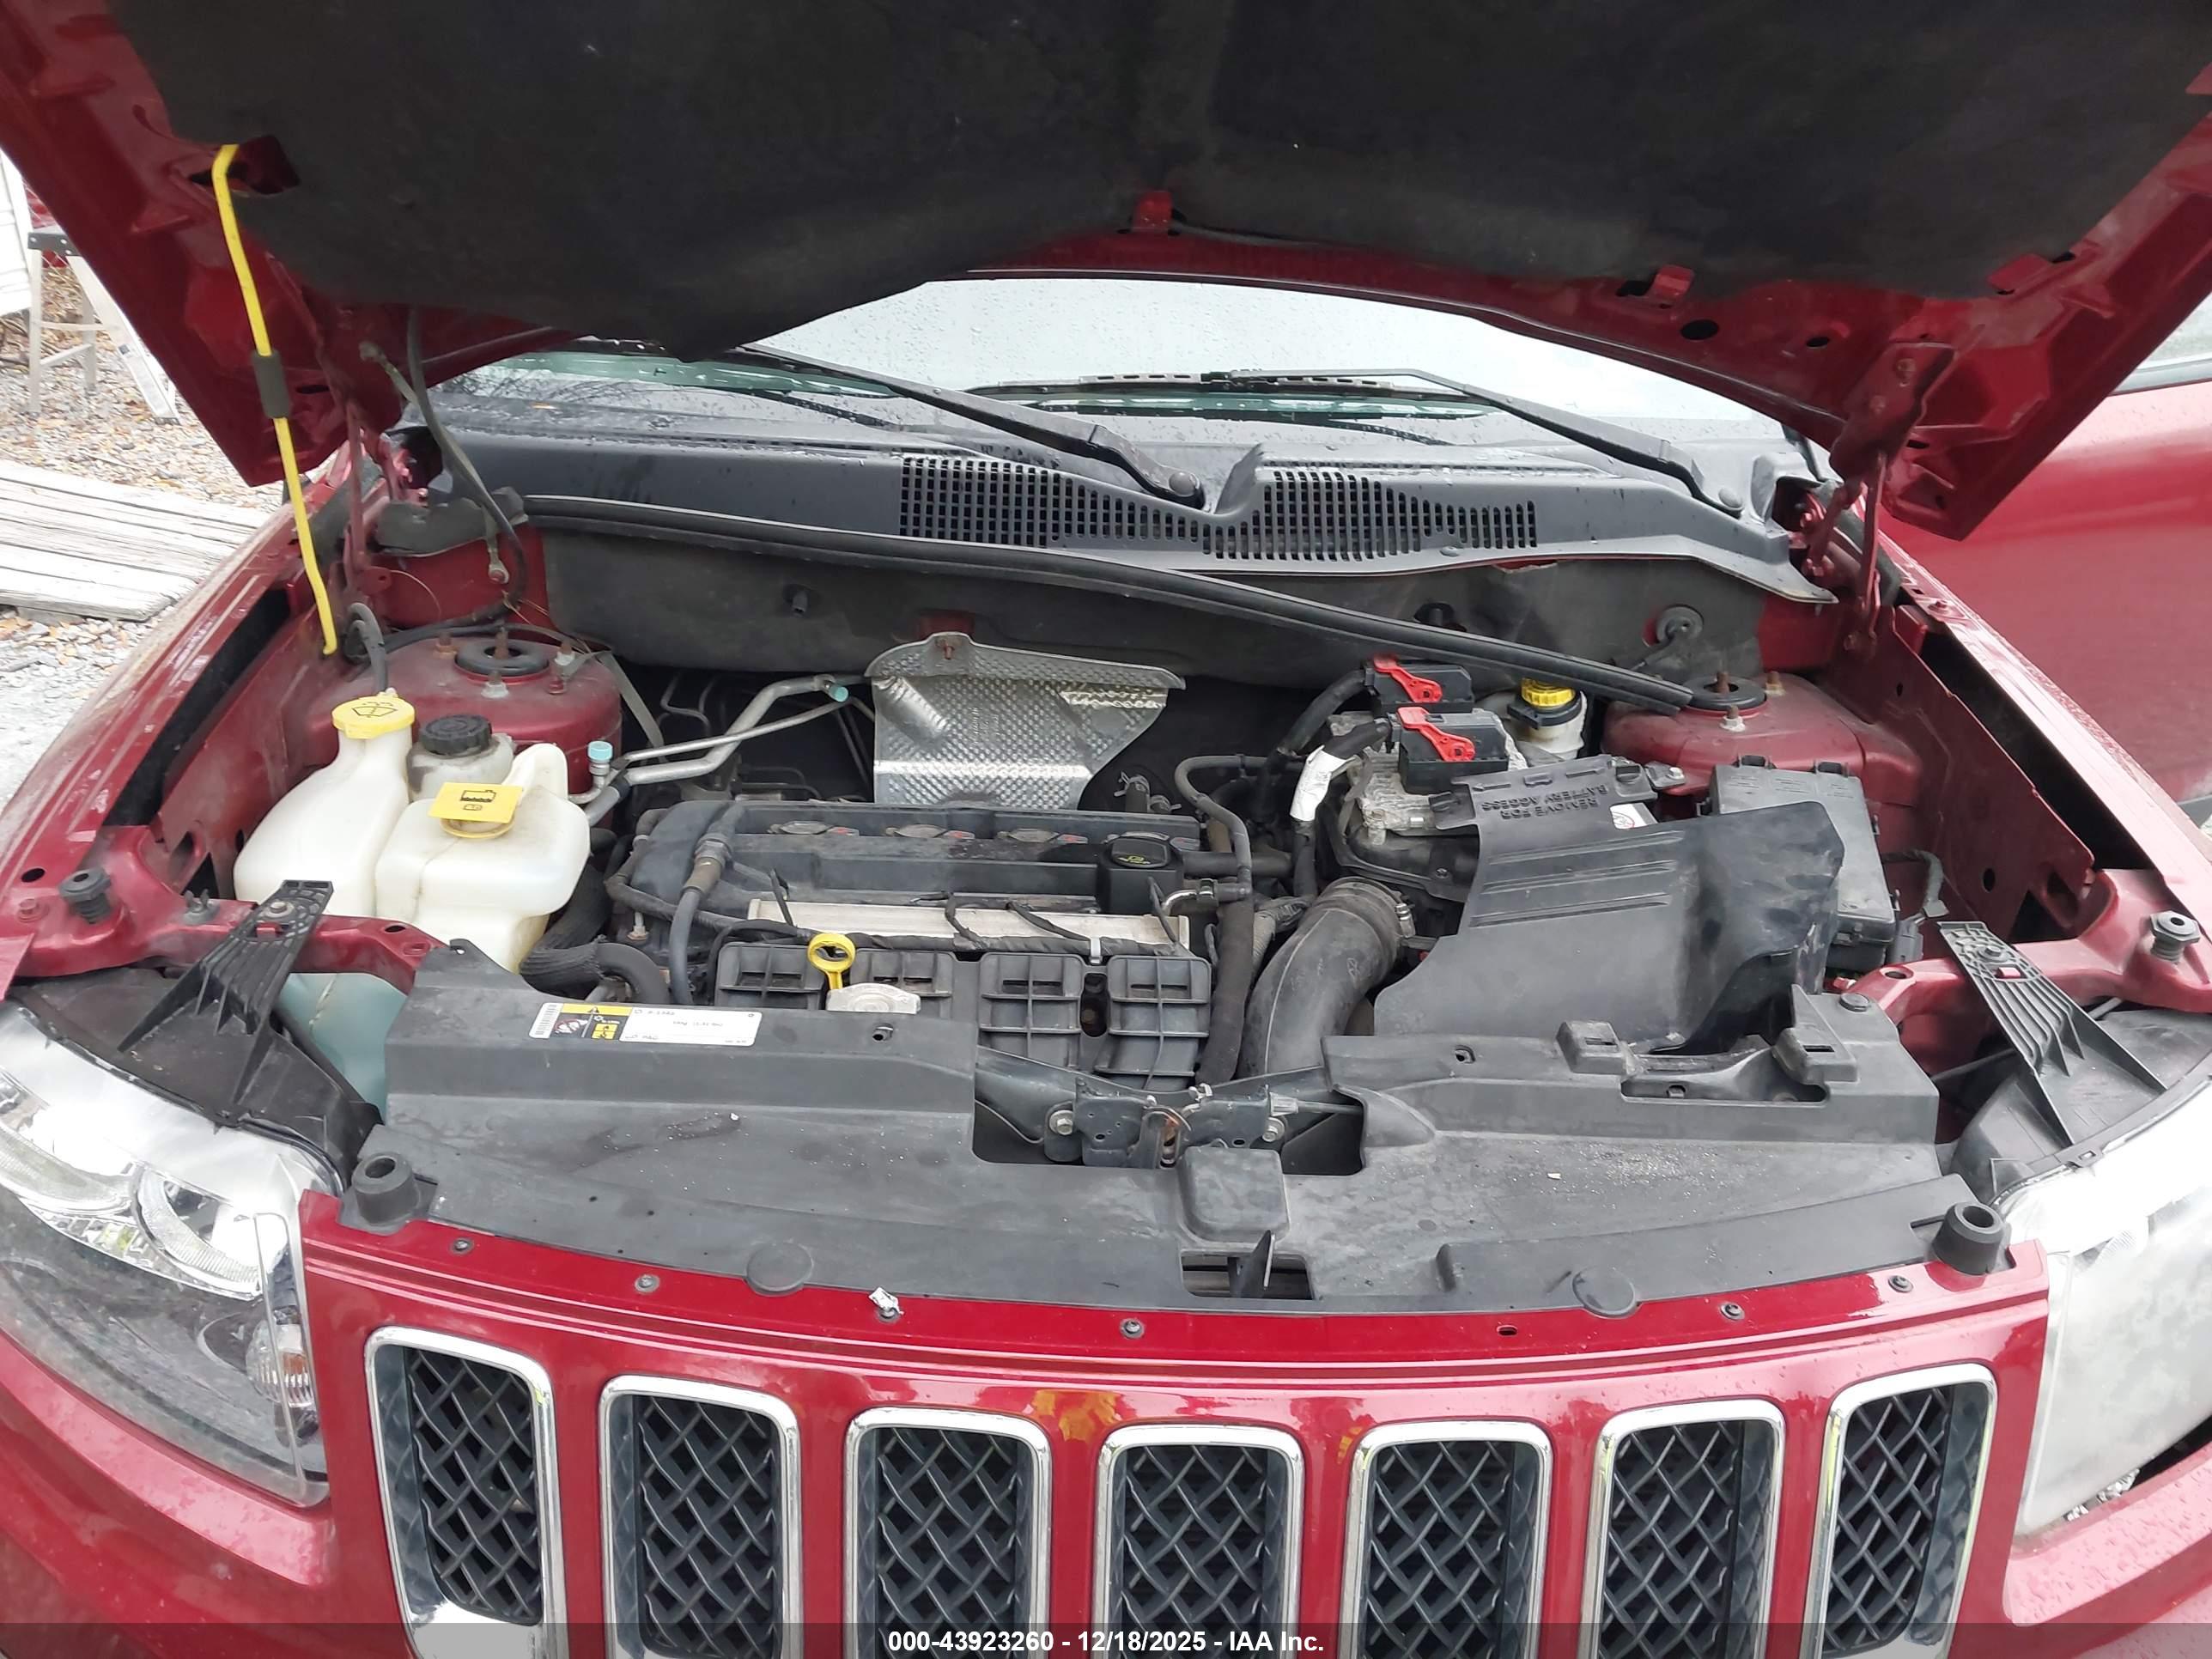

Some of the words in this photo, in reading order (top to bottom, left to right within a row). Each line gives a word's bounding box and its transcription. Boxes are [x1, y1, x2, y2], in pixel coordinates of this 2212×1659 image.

[1544, 783, 1608, 804] BATTERY
[1481, 795, 1538, 811] ACCESS
[1534, 797, 1599, 817] REMOVE
[1500, 808, 1531, 820] FOR
